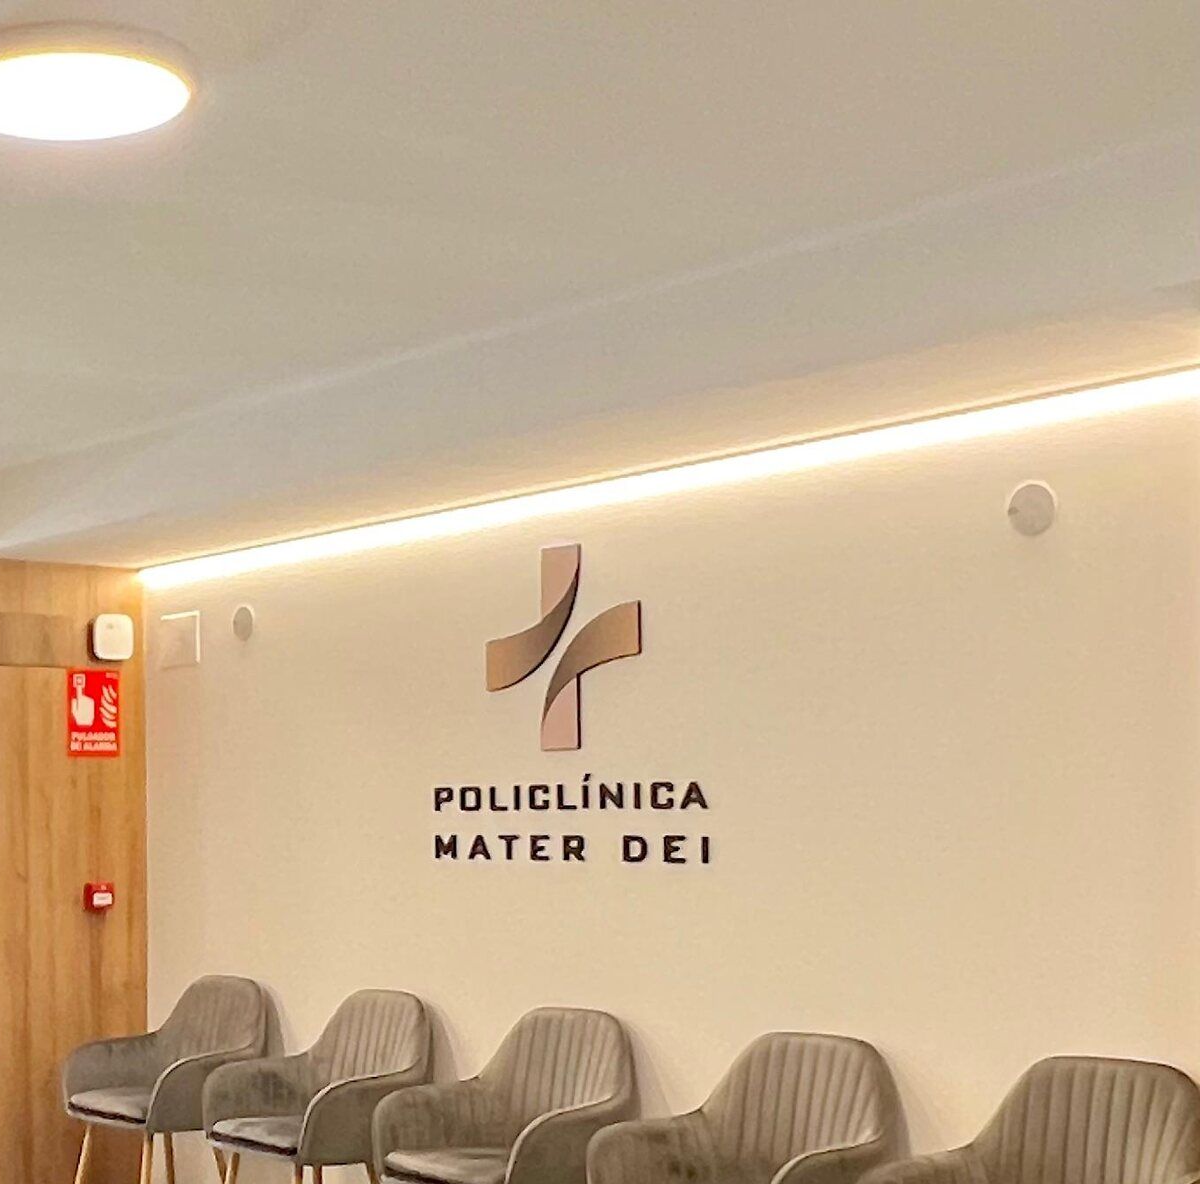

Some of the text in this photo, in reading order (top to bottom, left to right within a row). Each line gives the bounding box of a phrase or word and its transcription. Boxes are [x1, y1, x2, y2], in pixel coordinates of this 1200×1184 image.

[434, 773, 709, 811] POLICLÍNICA
[434, 834, 710, 864] MATER DEI
